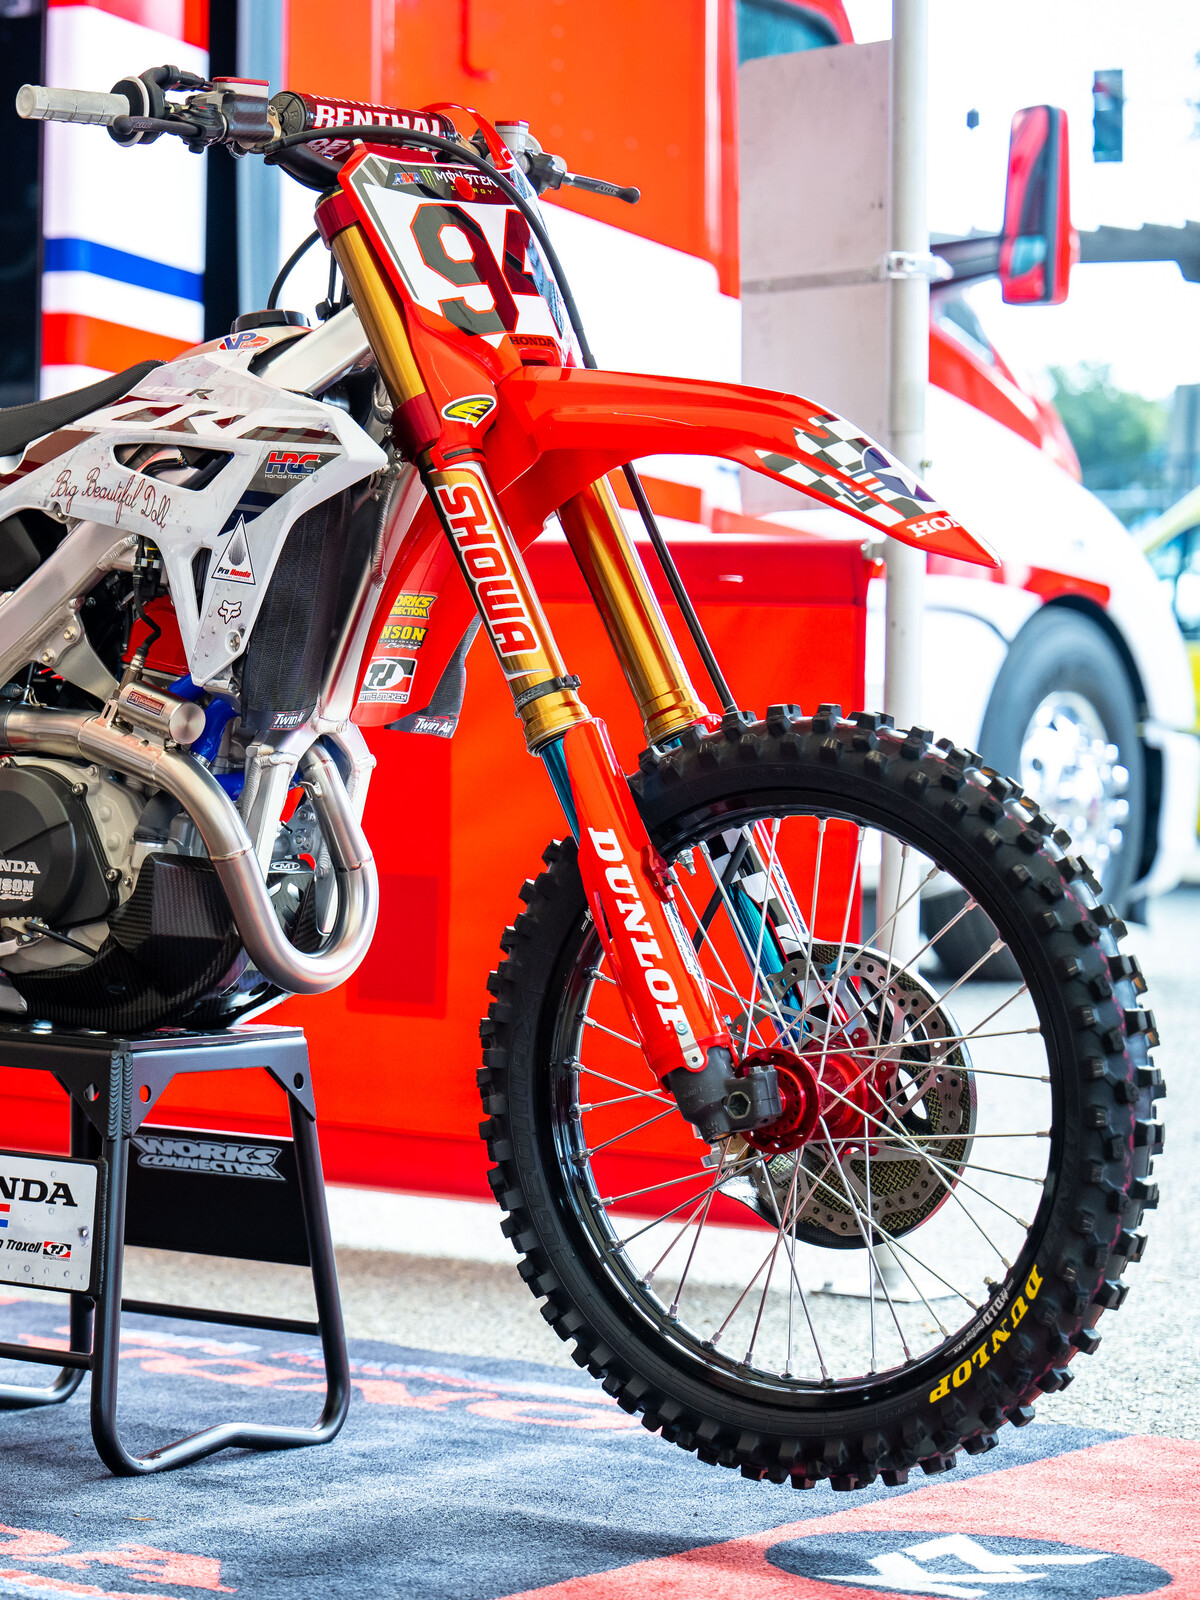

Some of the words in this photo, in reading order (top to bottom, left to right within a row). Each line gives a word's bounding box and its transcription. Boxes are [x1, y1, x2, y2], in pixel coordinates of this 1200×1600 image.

[312, 104, 447, 138] RENTHAL
[392, 172, 424, 186] AMA
[450, 184, 493, 196] ERGY
[594, 184, 620, 195] ARC
[410, 202, 565, 338] 94
[224, 332, 257, 350] VP
[509, 336, 556, 348] HONDA
[139, 387, 214, 400] 450R
[264, 451, 321, 475] HRC
[50, 469, 79, 513] Big
[81, 467, 144, 525] Beautiful
[140, 485, 172, 530] Doll
[216, 566, 230, 575] Pro
[230, 568, 252, 579] Honda
[433, 482, 541, 658] SHOWA
[394, 594, 436, 608] ORKS
[380, 625, 428, 641] NSON
[274, 713, 298, 725] Twin
[414, 718, 440, 731] Twin
[437, 720, 454, 733] Air
[133, 1134, 282, 1164] WORKS
[137, 1153, 286, 1181] CONNECTION
[5, 1239, 42, 1254] Troxell
[928, 1263, 1043, 1403] DUNLOP
